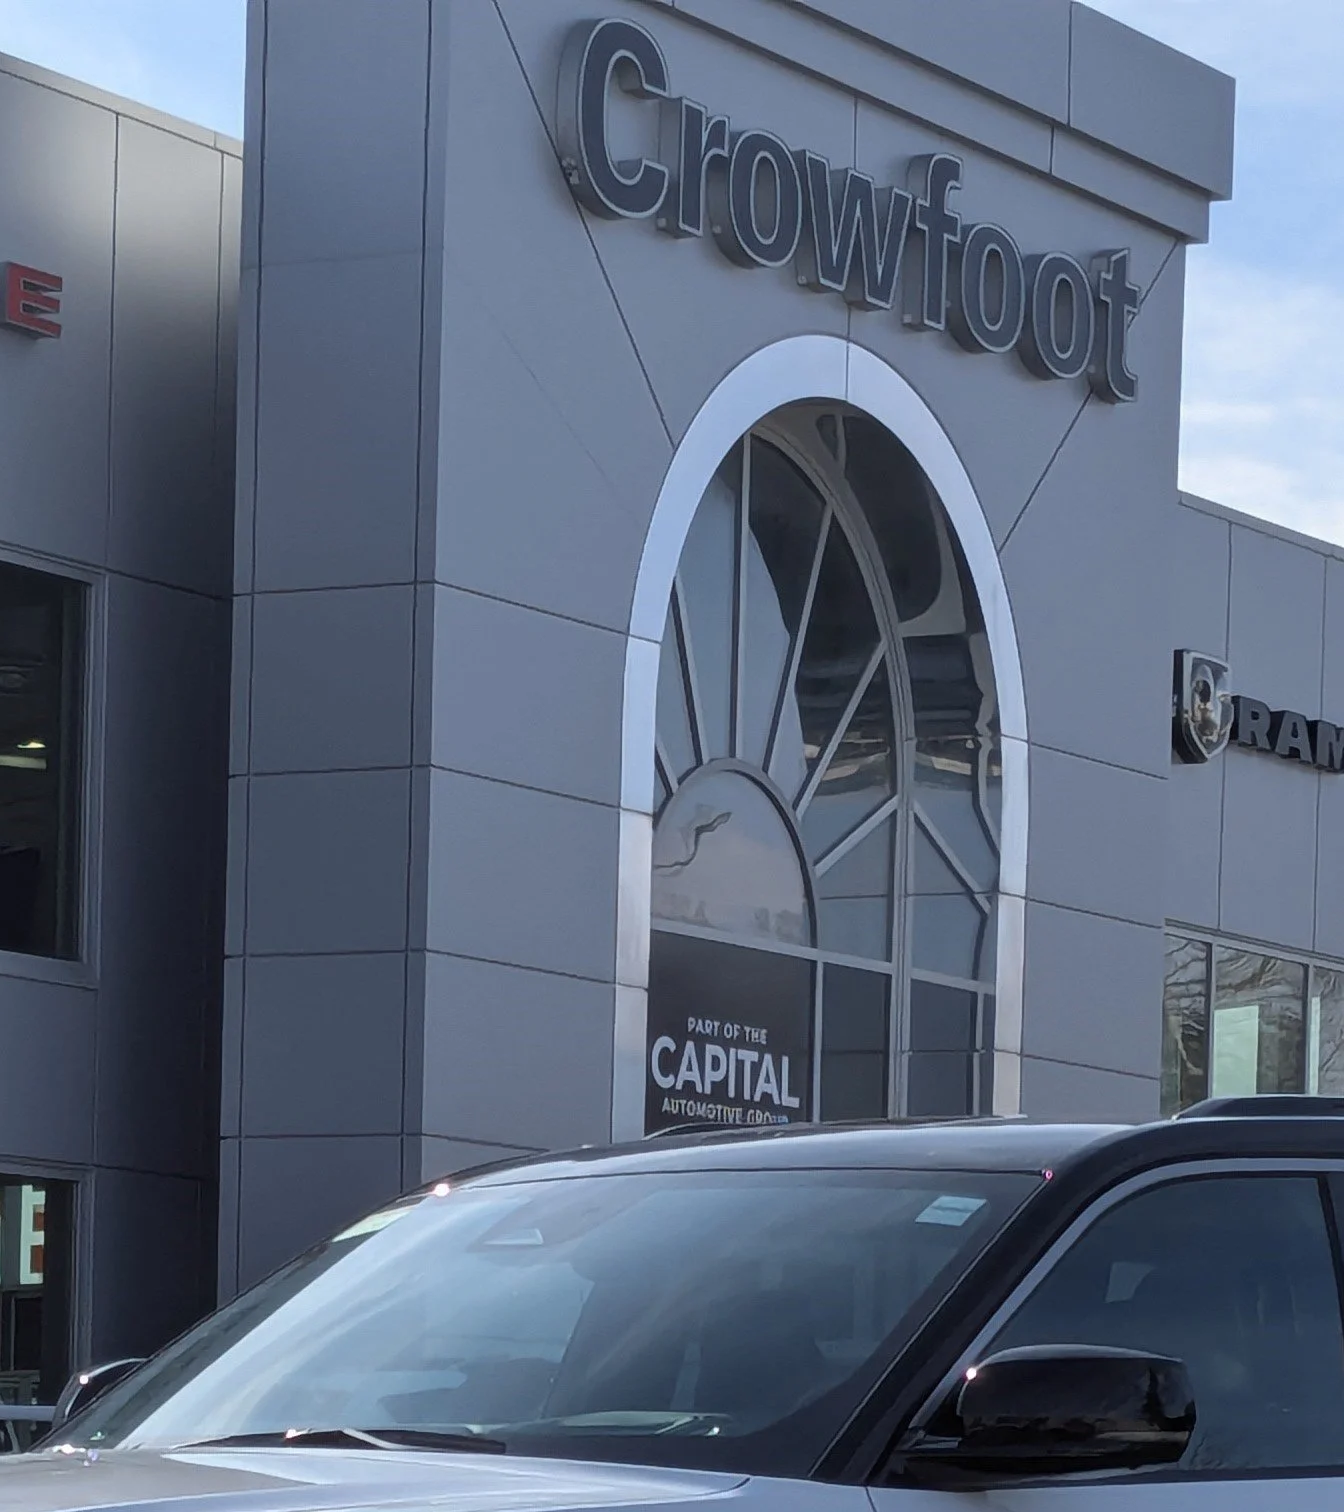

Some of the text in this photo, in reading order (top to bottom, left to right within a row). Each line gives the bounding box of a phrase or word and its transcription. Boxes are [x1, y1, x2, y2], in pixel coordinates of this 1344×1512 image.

[564, 17, 1142, 403] Crowfoot
[687, 1016, 768, 1045] PART OF THE
[651, 1035, 800, 1109] CAPITAL
[661, 1097, 743, 1124] AUTOMOTIVE
